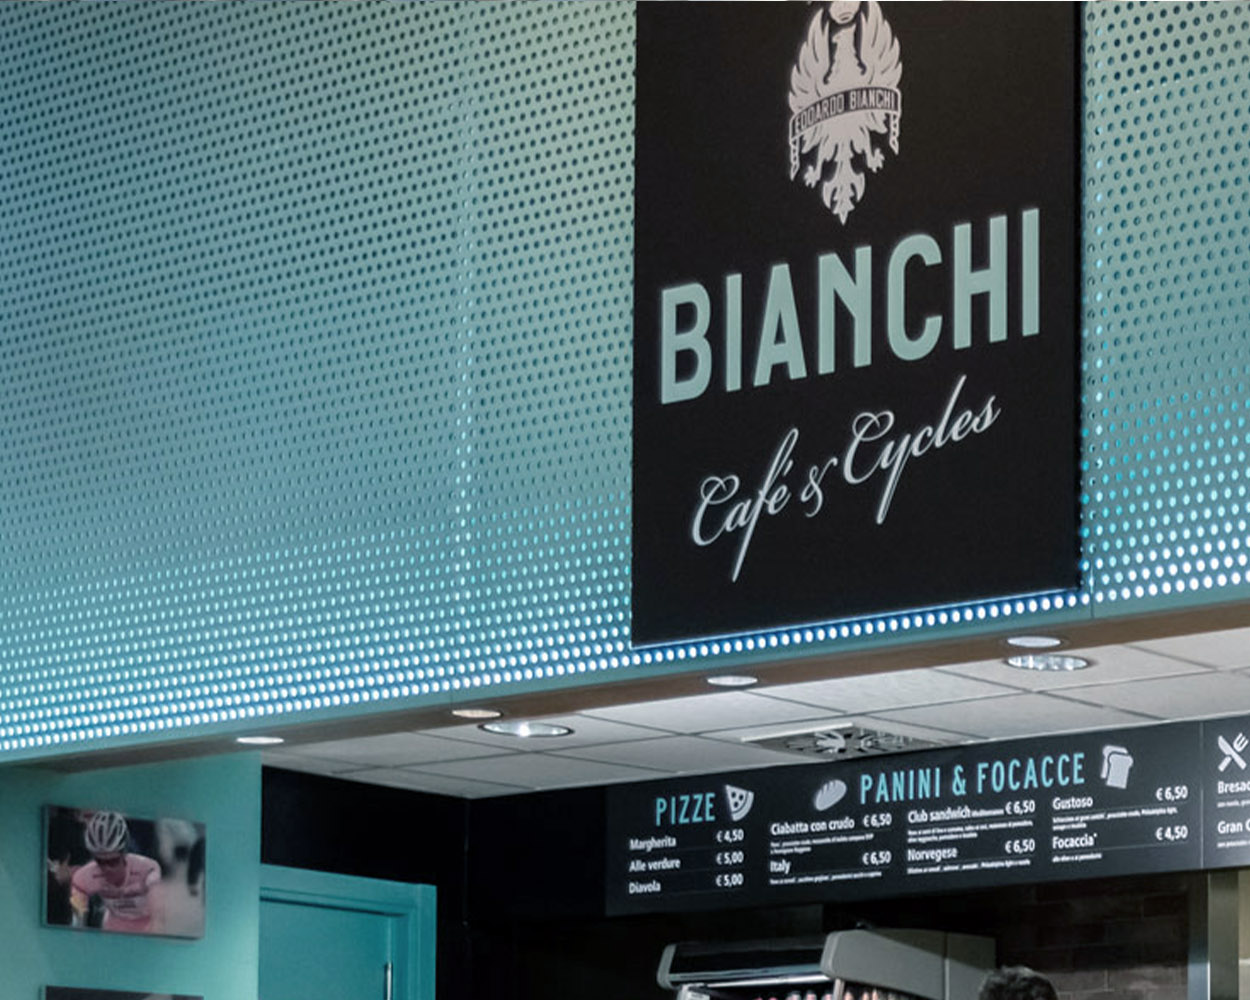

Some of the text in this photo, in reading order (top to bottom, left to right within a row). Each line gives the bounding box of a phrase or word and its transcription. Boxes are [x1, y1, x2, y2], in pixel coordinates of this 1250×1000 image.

[850, 90, 896, 110] BIANCHI
[661, 208, 1039, 405] BIANCHI
[691, 374, 1001, 582] Café & Cycles
[860, 752, 1085, 804] PANINI & FOCACCE
[1052, 797, 1093, 810] Gustoso
[1164, 785, 1188, 801] 6,50
[655, 792, 716, 826] PIZZE
[908, 809, 928, 823] Club
[930, 805, 970, 821] sandwich
[1013, 800, 1035, 815] 6,50
[771, 822, 808, 835] Ciabatta
[810, 822, 827, 832] con
[828, 816, 855, 830] crudo
[871, 813, 892, 828] 6,50
[1164, 825, 1188, 841] 4,50
[1217, 821, 1242, 834] Gran
[629, 835, 677, 852] Margherita
[908, 848, 957, 862] Norvegese
[1013, 839, 1035, 853] 6,50
[629, 860, 646, 872] Alle
[724, 851, 744, 865] 5,00
[870, 851, 892, 865] 6,50
[724, 873, 744, 887] 5,00
